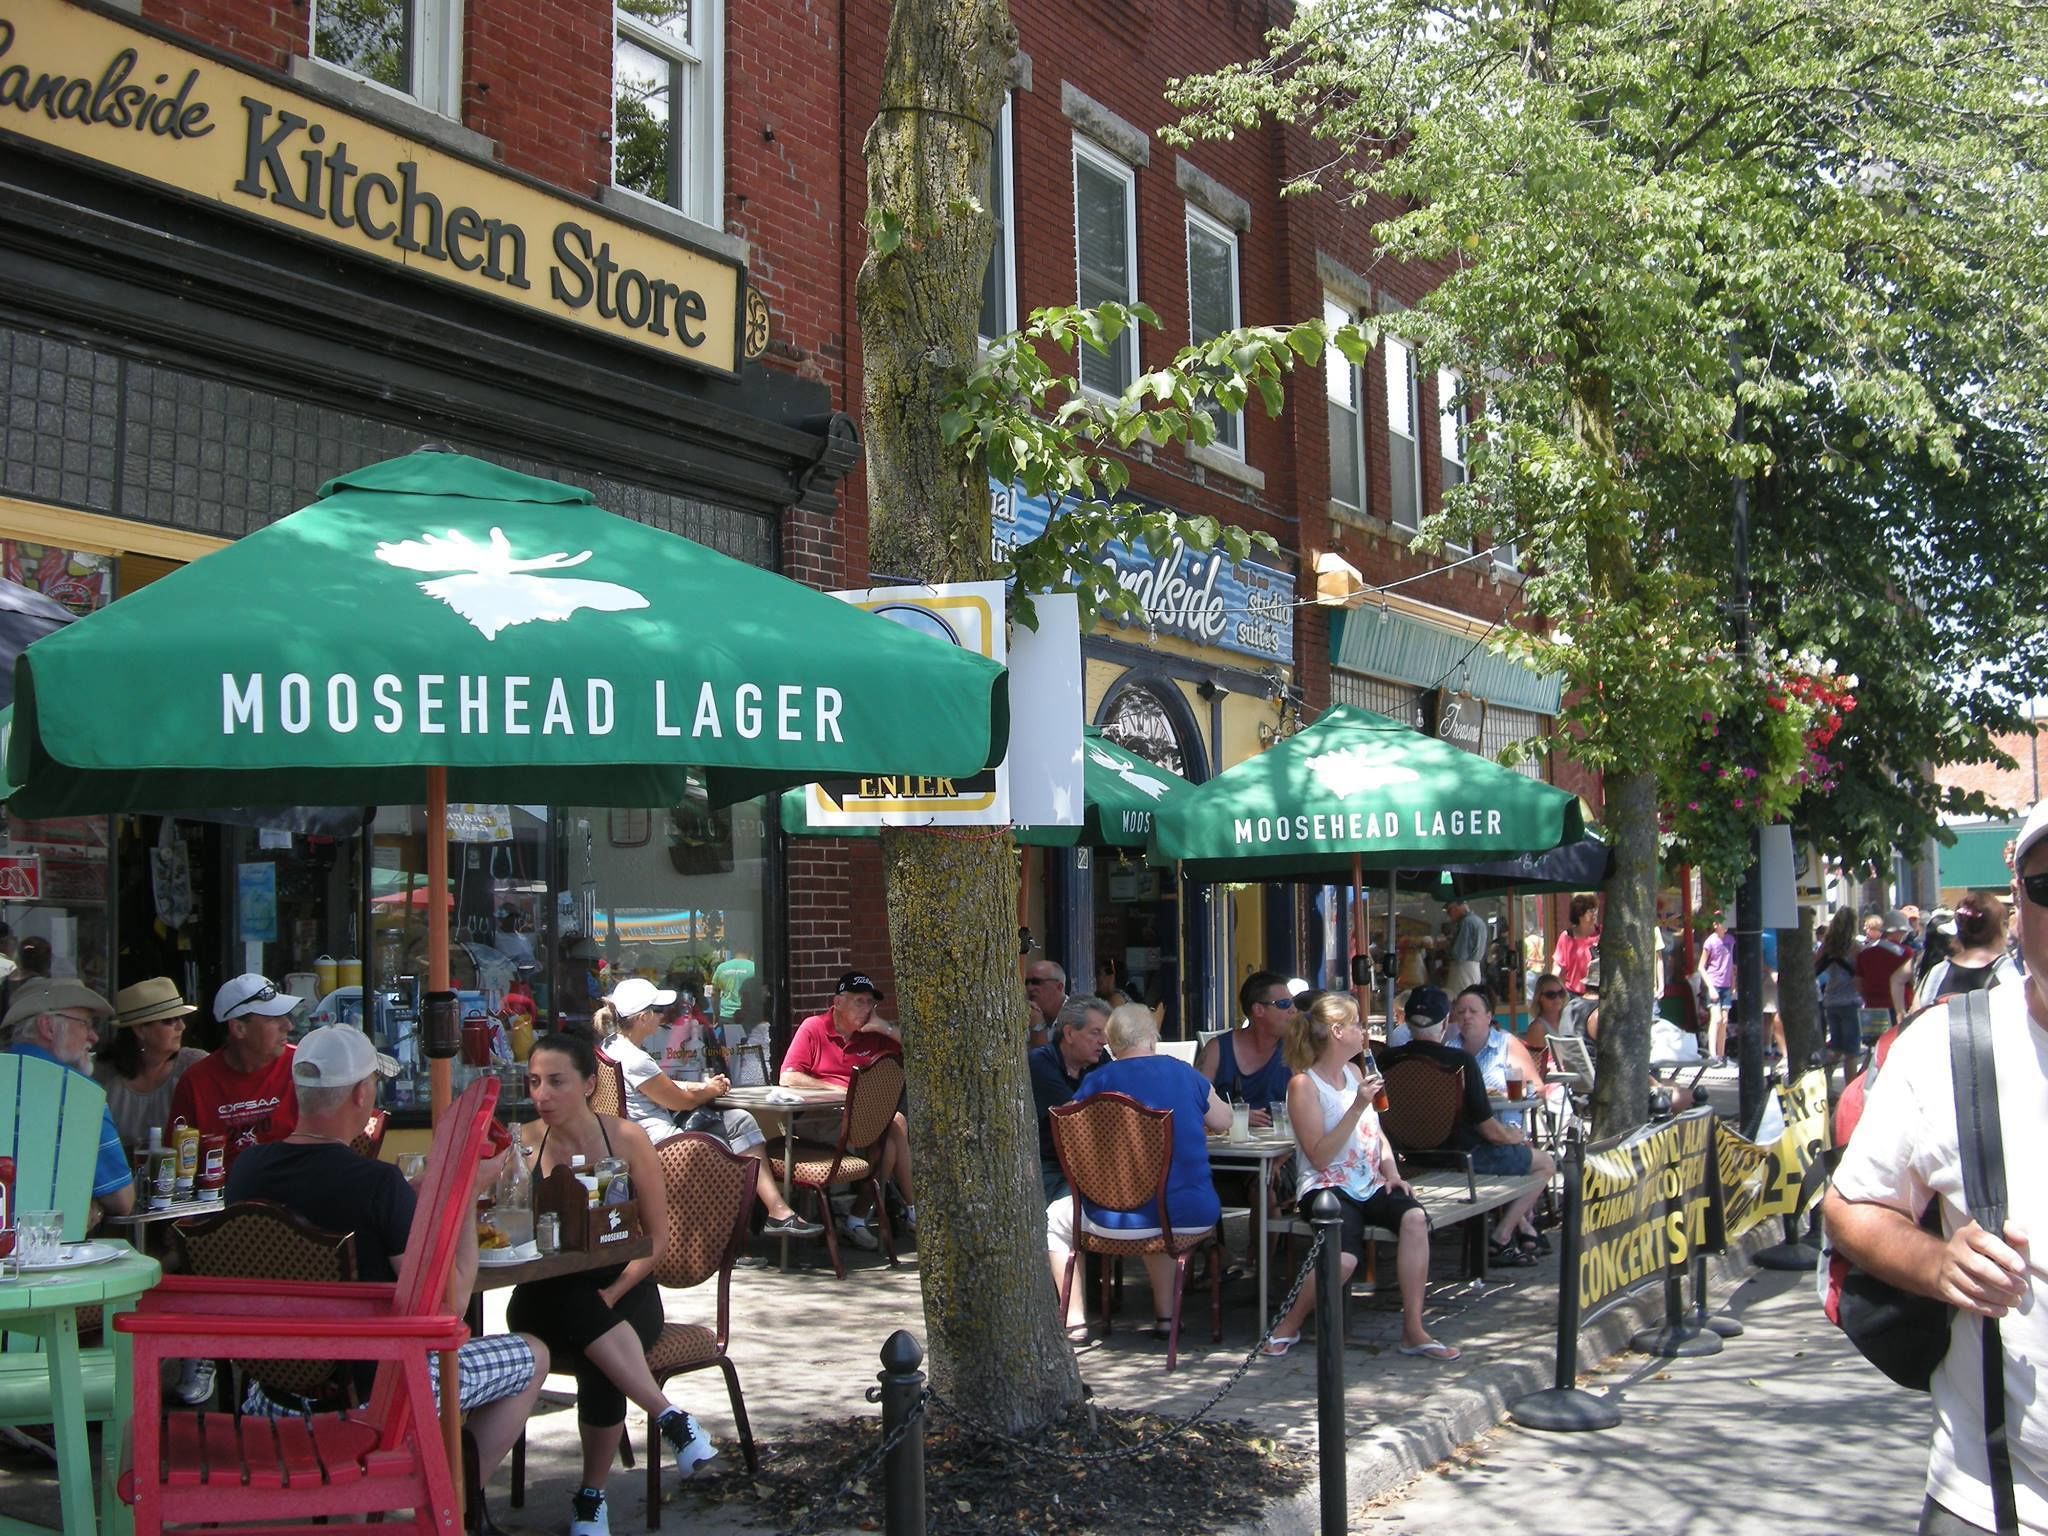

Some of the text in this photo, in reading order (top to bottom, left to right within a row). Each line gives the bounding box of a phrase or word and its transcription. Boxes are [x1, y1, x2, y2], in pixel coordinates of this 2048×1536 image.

[234, 95, 531, 289] Kitchen
[550, 221, 707, 348] Store
[1248, 589, 1290, 625] studio
[1237, 618, 1279, 653] suites
[221, 672, 844, 744] MOOSEHEAD LAGER
[858, 774, 958, 798] ENTER
[1234, 809, 1501, 844] MOOSEHEAD LAGER
[218, 1096, 280, 1114] OFSAA
[1581, 1191, 1638, 1236] ACHMAN
[600, 1230, 629, 1243] MOOSEHEAD
